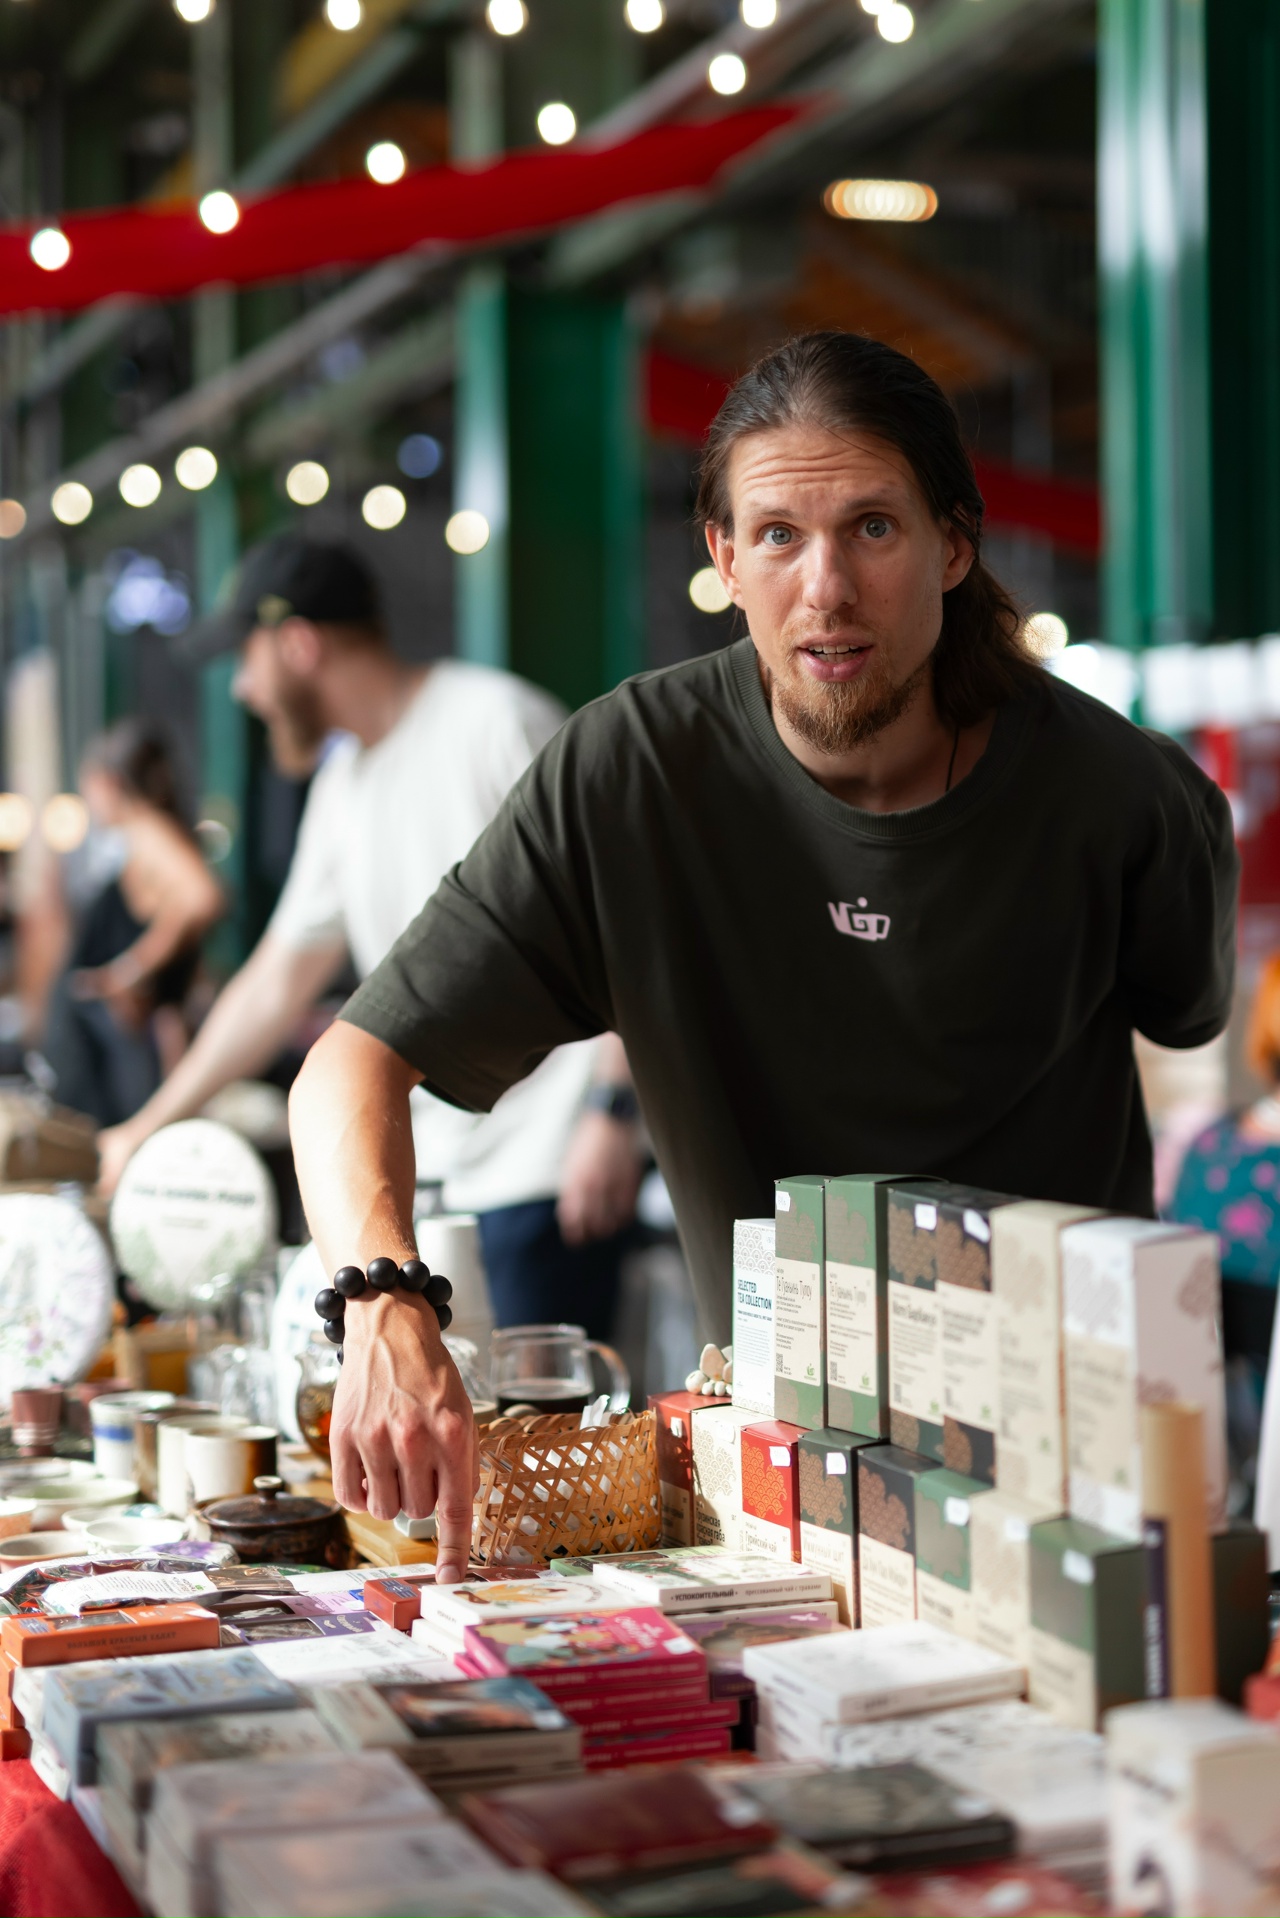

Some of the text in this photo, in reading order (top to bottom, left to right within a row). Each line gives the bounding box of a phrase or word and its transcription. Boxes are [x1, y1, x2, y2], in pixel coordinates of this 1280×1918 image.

[738, 1279, 757, 1293] SELECTED
[745, 1293, 772, 1310] COLLECTION
[675, 1589, 734, 1601] УСПОКОИТЕЛЬНЫЙ
